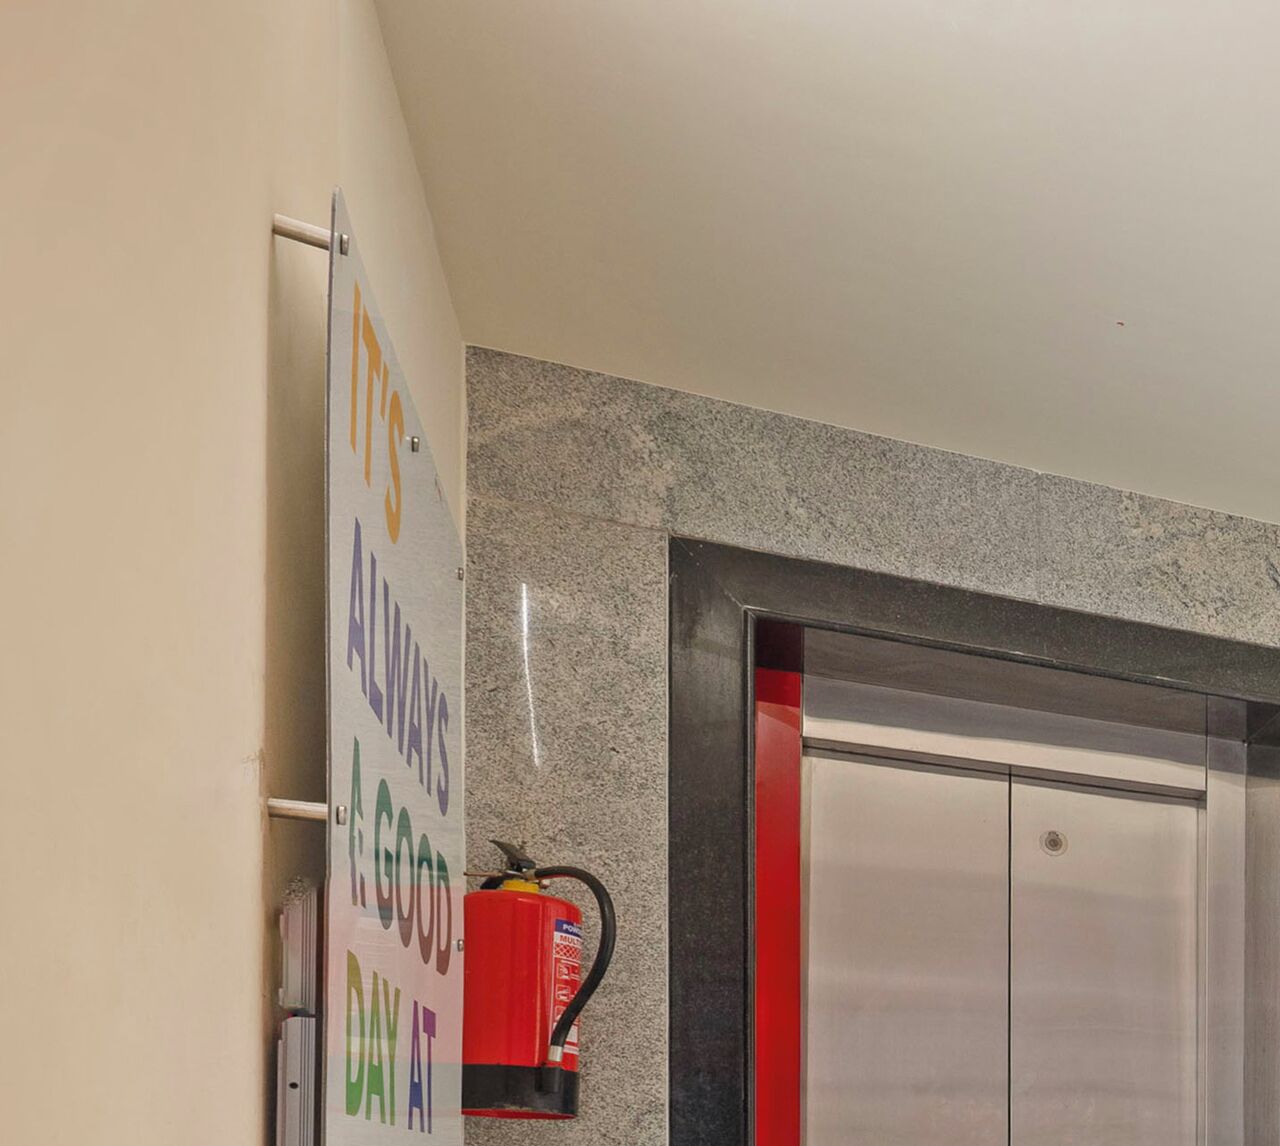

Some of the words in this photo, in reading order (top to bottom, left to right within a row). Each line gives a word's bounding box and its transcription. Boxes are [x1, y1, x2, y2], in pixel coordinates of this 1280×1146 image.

[350, 280, 404, 544] IT'S
[346, 515, 450, 817] ALWAYS
[374, 778, 453, 976] GOOD
[345, 948, 401, 1127] DAY
[407, 999, 437, 1135] AT
